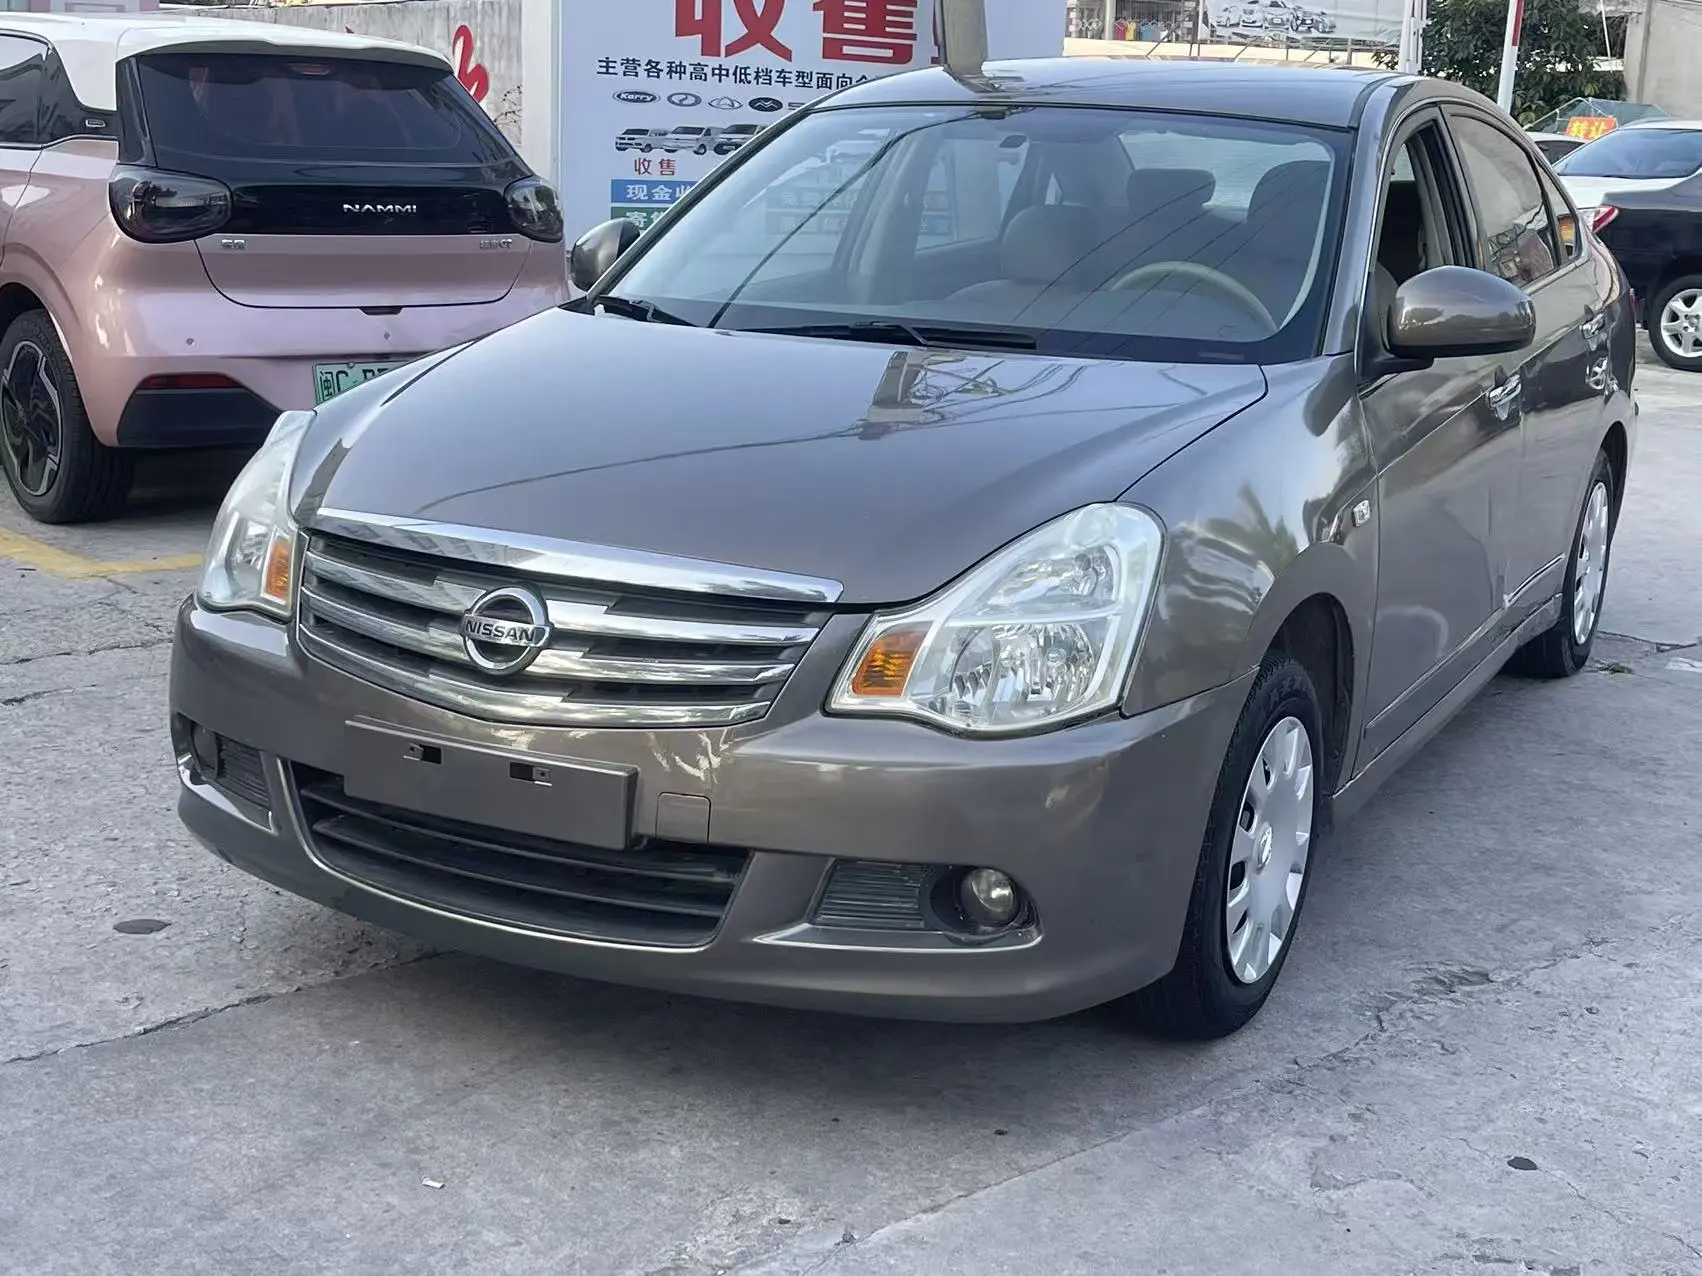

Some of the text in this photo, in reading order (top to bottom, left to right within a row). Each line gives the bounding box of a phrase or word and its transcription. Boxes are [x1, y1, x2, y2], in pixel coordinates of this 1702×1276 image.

[675, 0, 946, 64] 收售
[634, 157, 676, 176] 收售
[343, 204, 417, 213] NAMMI
[465, 620, 535, 642] NISSAN
